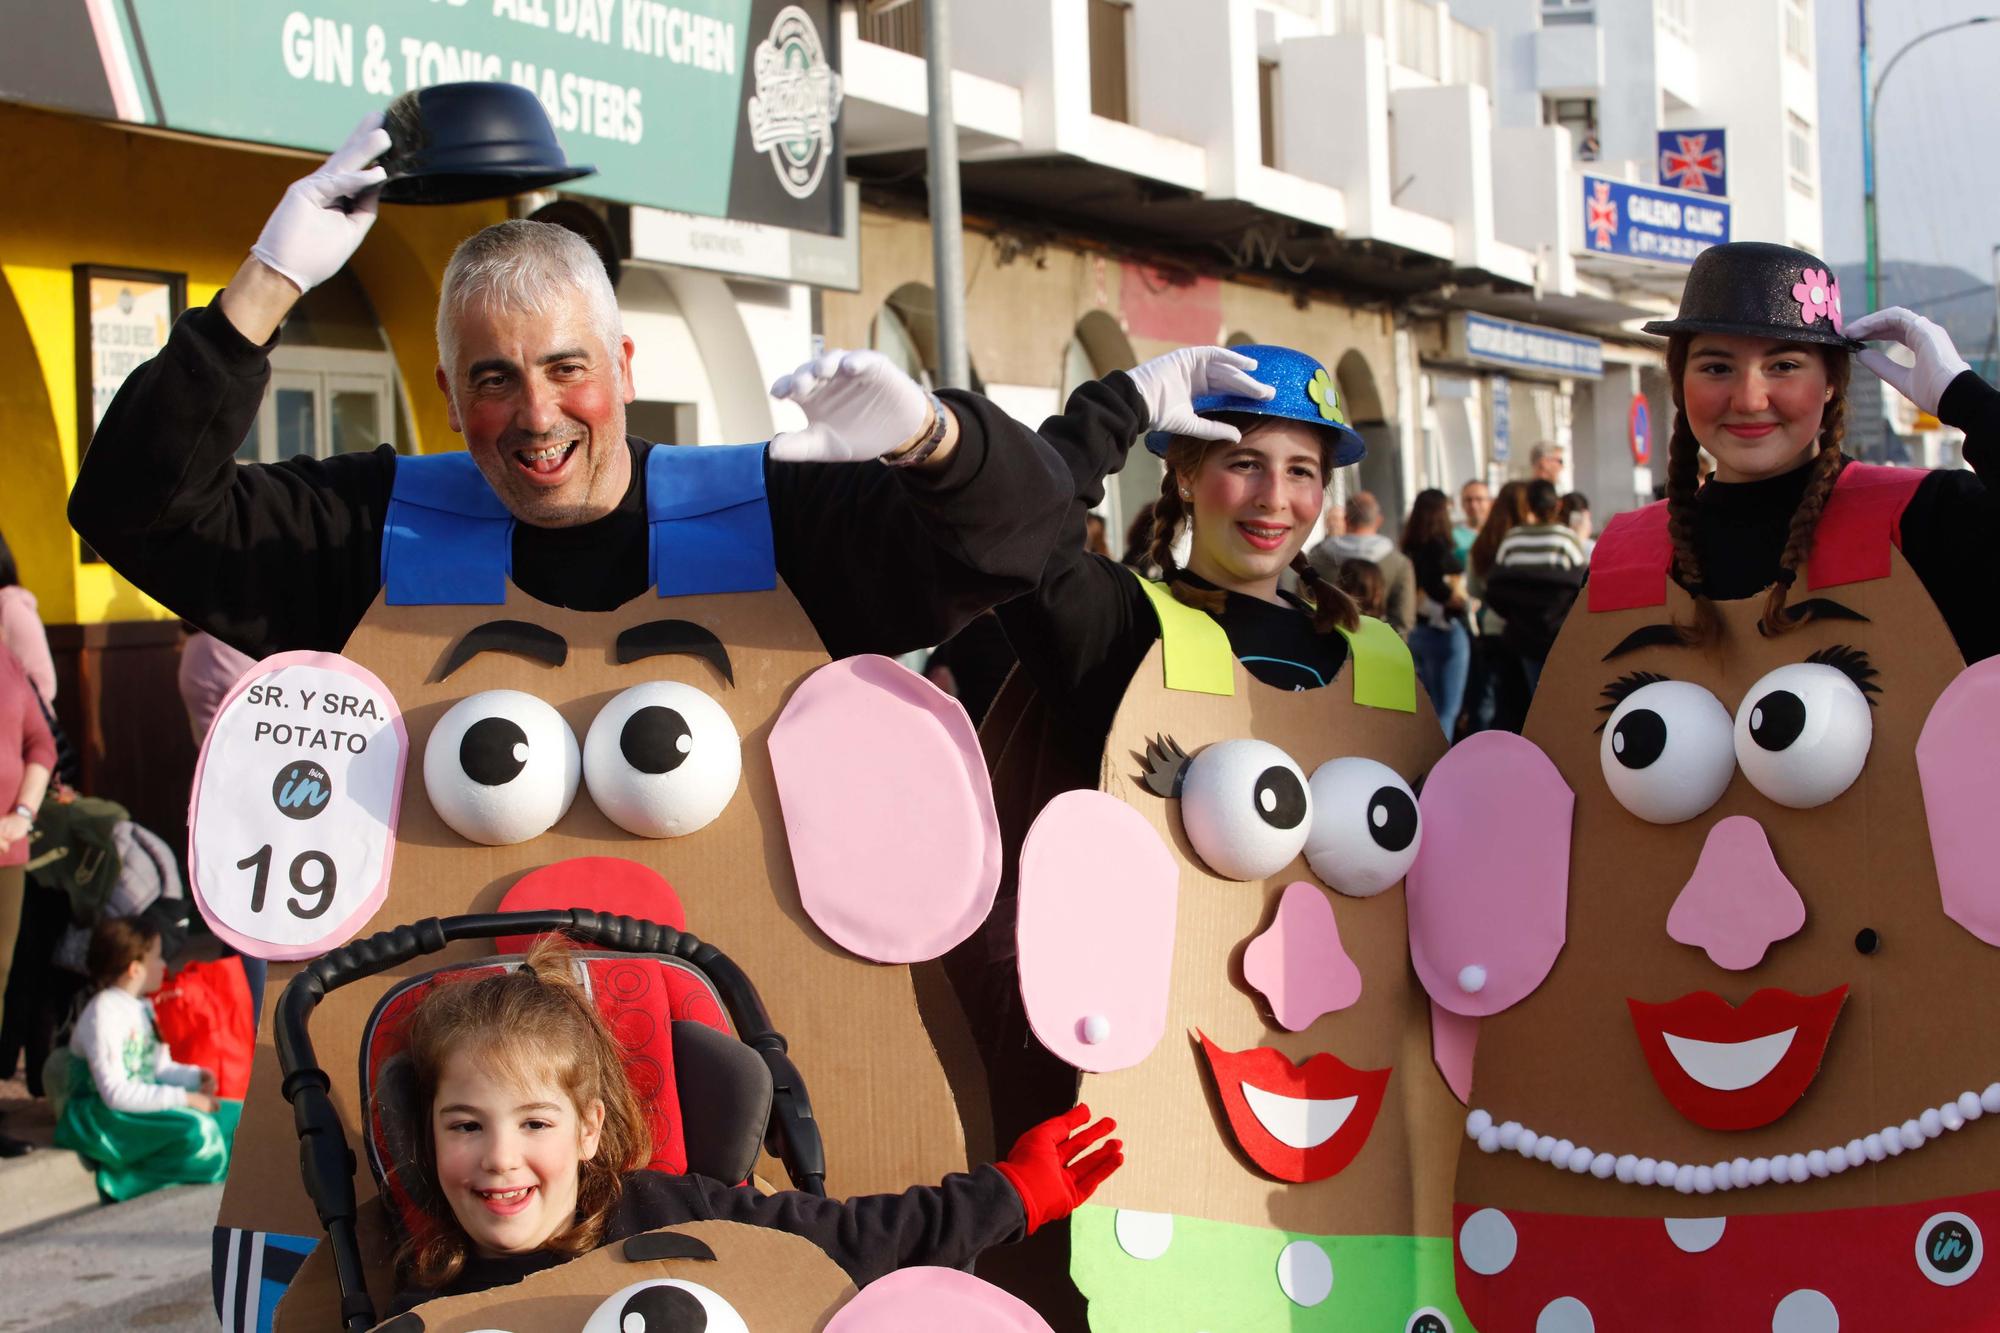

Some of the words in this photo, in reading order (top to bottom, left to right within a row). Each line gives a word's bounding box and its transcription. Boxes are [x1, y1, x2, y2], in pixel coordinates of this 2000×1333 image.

[282, 11, 353, 87] GIN
[362, 24, 393, 96] &
[555, 0, 616, 45] DAY
[622, 0, 736, 75] KITCHEN
[1627, 194, 1682, 230] GALENO
[1684, 205, 1724, 237] CLINIC
[247, 685, 289, 708] SR.
[300, 689, 317, 711] Y
[322, 693, 384, 721] SRA.
[254, 721, 367, 754] POTATO
[279, 768, 330, 808] in
[236, 844, 338, 920] 19
[1933, 1231, 1967, 1261] in
